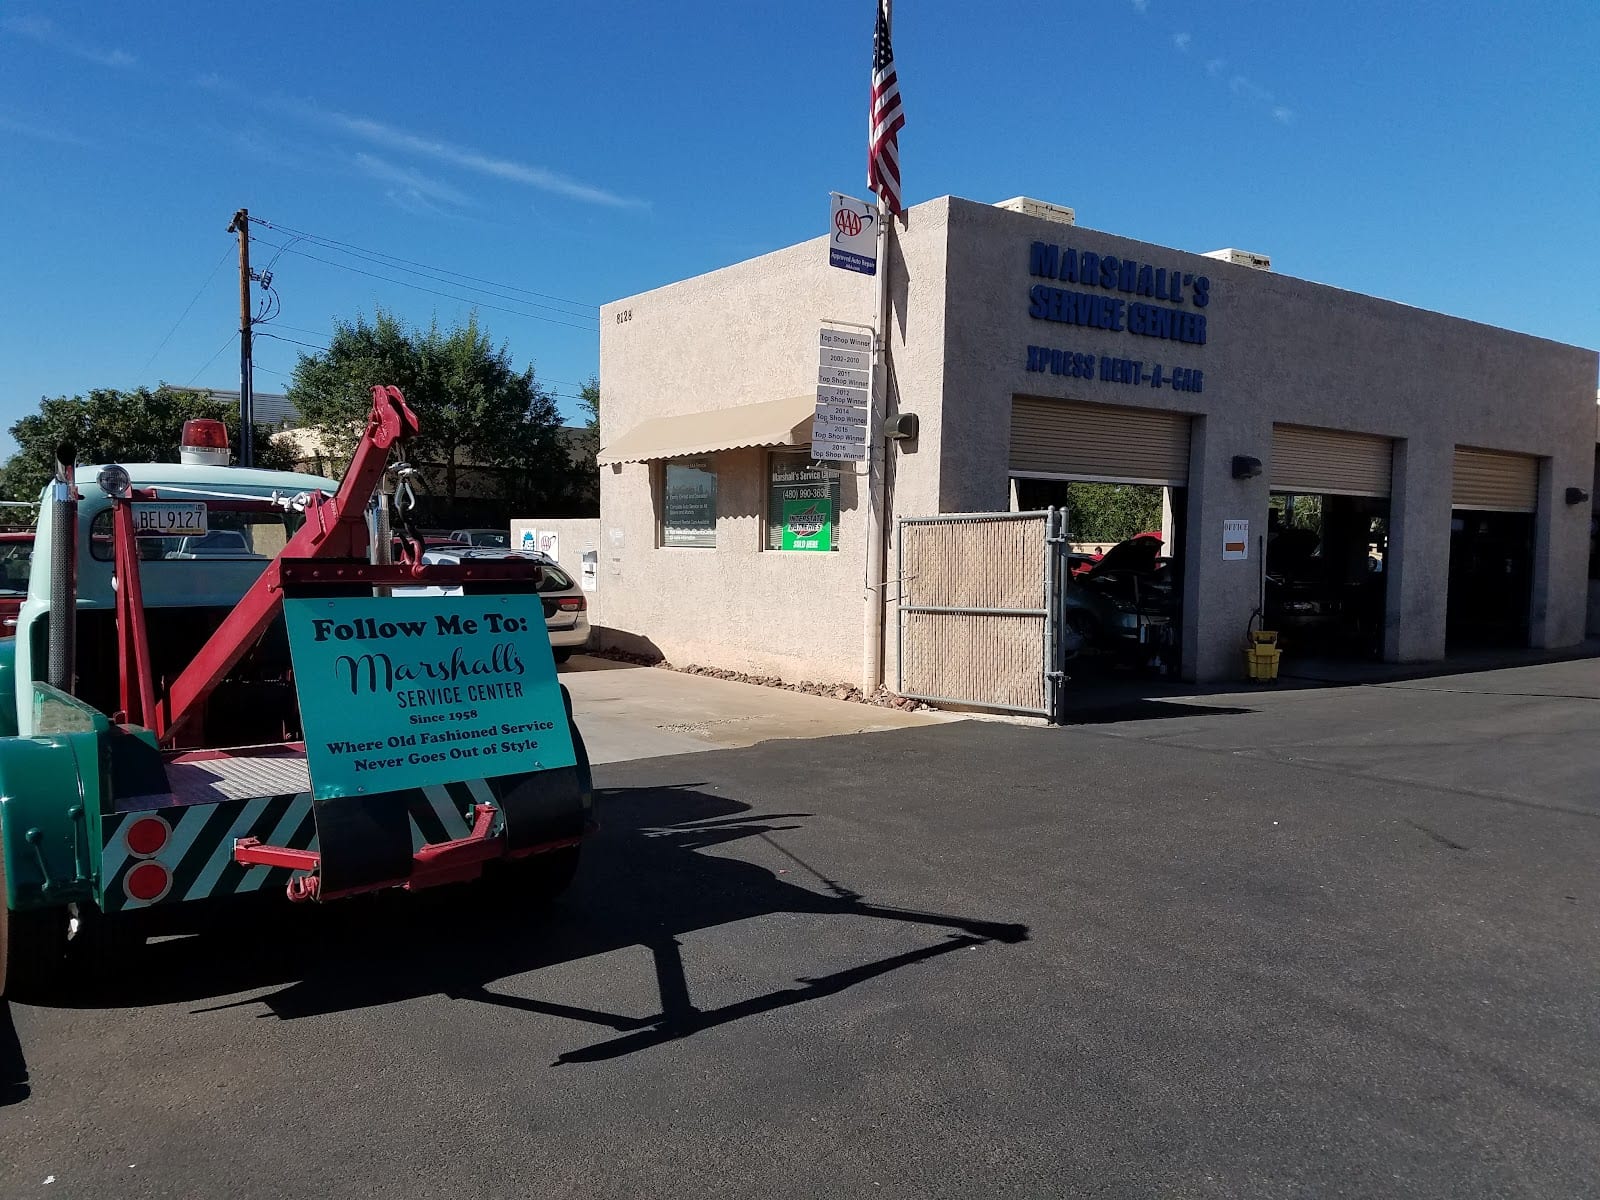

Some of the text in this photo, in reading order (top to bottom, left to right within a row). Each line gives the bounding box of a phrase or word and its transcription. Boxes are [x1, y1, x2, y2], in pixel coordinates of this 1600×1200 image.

[837, 209, 861, 235] AAA
[1030, 241, 1210, 307] MARSHALL'S
[1029, 284, 1207, 344] SERVICE CENTER
[820, 334, 871, 348] Top Shop Winner
[1026, 345, 1096, 379] XPRESS
[819, 375, 869, 388] Top Shop Winner
[818, 394, 867, 406] Top Shop Winner
[817, 413, 867, 425] Top Shop Winner
[835, 407, 850, 415] 2014
[815, 431, 866, 442] Top Shop Winner
[813, 450, 865, 460] Top Shop Winner
[800, 471, 821, 480] Service
[140, 511, 202, 529] BEL9127
[312, 613, 528, 641] Follow Me To:
[397, 681, 524, 708] SERVICE CENTER
[409, 709, 478, 725] Since 1958
[327, 719, 554, 755] Where Old Fashioned Service
[354, 738, 539, 772] Never Goes Out of Style
